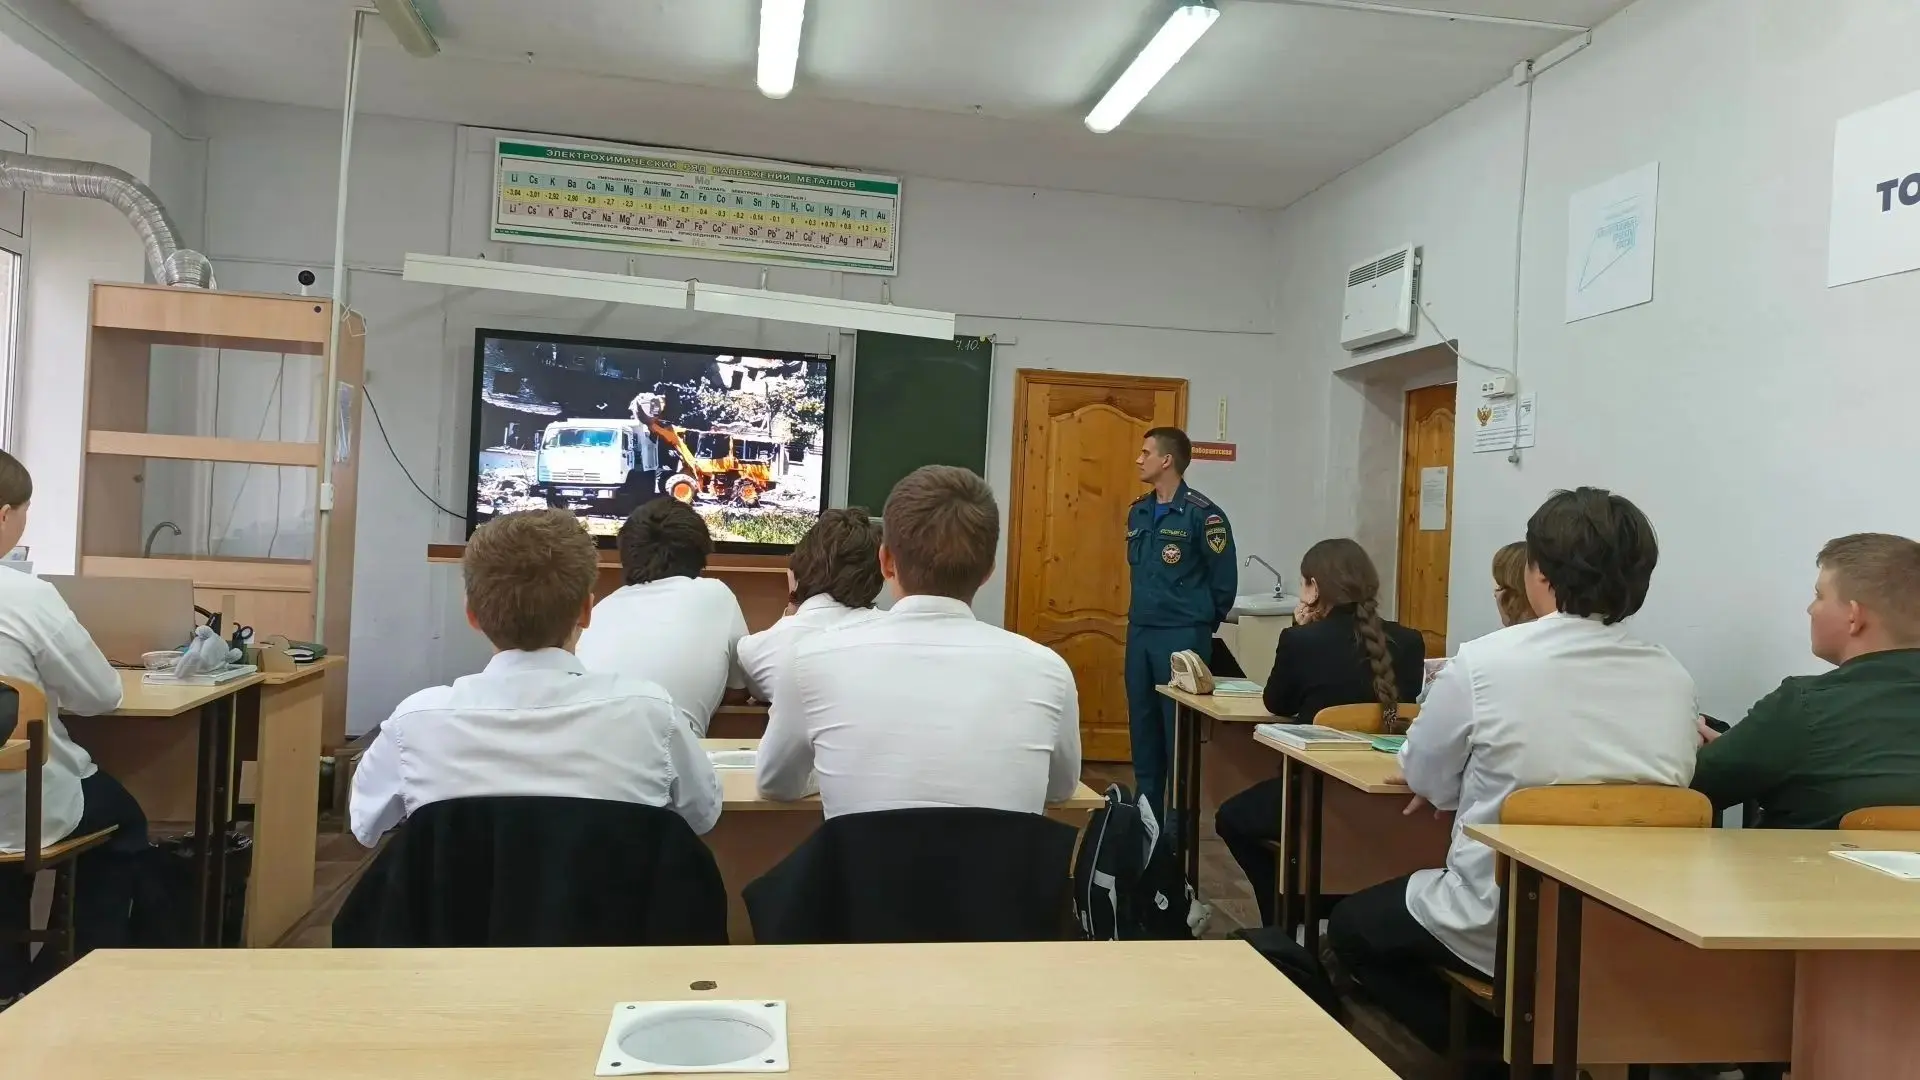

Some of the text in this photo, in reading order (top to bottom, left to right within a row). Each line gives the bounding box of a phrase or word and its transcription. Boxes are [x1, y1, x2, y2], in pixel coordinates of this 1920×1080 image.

[546, 149, 856, 188] ЭЛЕКТРОХИМИЧЕСКИЙ РЯД НАПРЯЖЕНИЙ МЕТАЛЛОВ
[511, 173, 518, 182] Li
[529, 175, 539, 184] Cs
[550, 177, 556, 186] K
[567, 179, 577, 188] Ba
[586, 181, 596, 190] Ca
[605, 183, 615, 192] Na
[623, 184, 634, 196] Mg
[643, 187, 651, 196] Al
[660, 188, 671, 198] Mn
[680, 190, 689, 200] Zn
[698, 192, 707, 202] Fe
[716, 194, 726, 203] Co
[736, 196, 744, 205] Ni
[753, 198, 762, 207] Sn
[771, 199, 780, 209] Pb
[805, 203, 815, 212] Cu
[824, 205, 834, 217] Hg
[841, 207, 851, 218] Ag
[860, 209, 868, 218] Pt
[876, 211, 886, 220] Au
[1876, 172, 1920, 212] ТО
[622, 225, 653, 233] СВОЙСТВО
